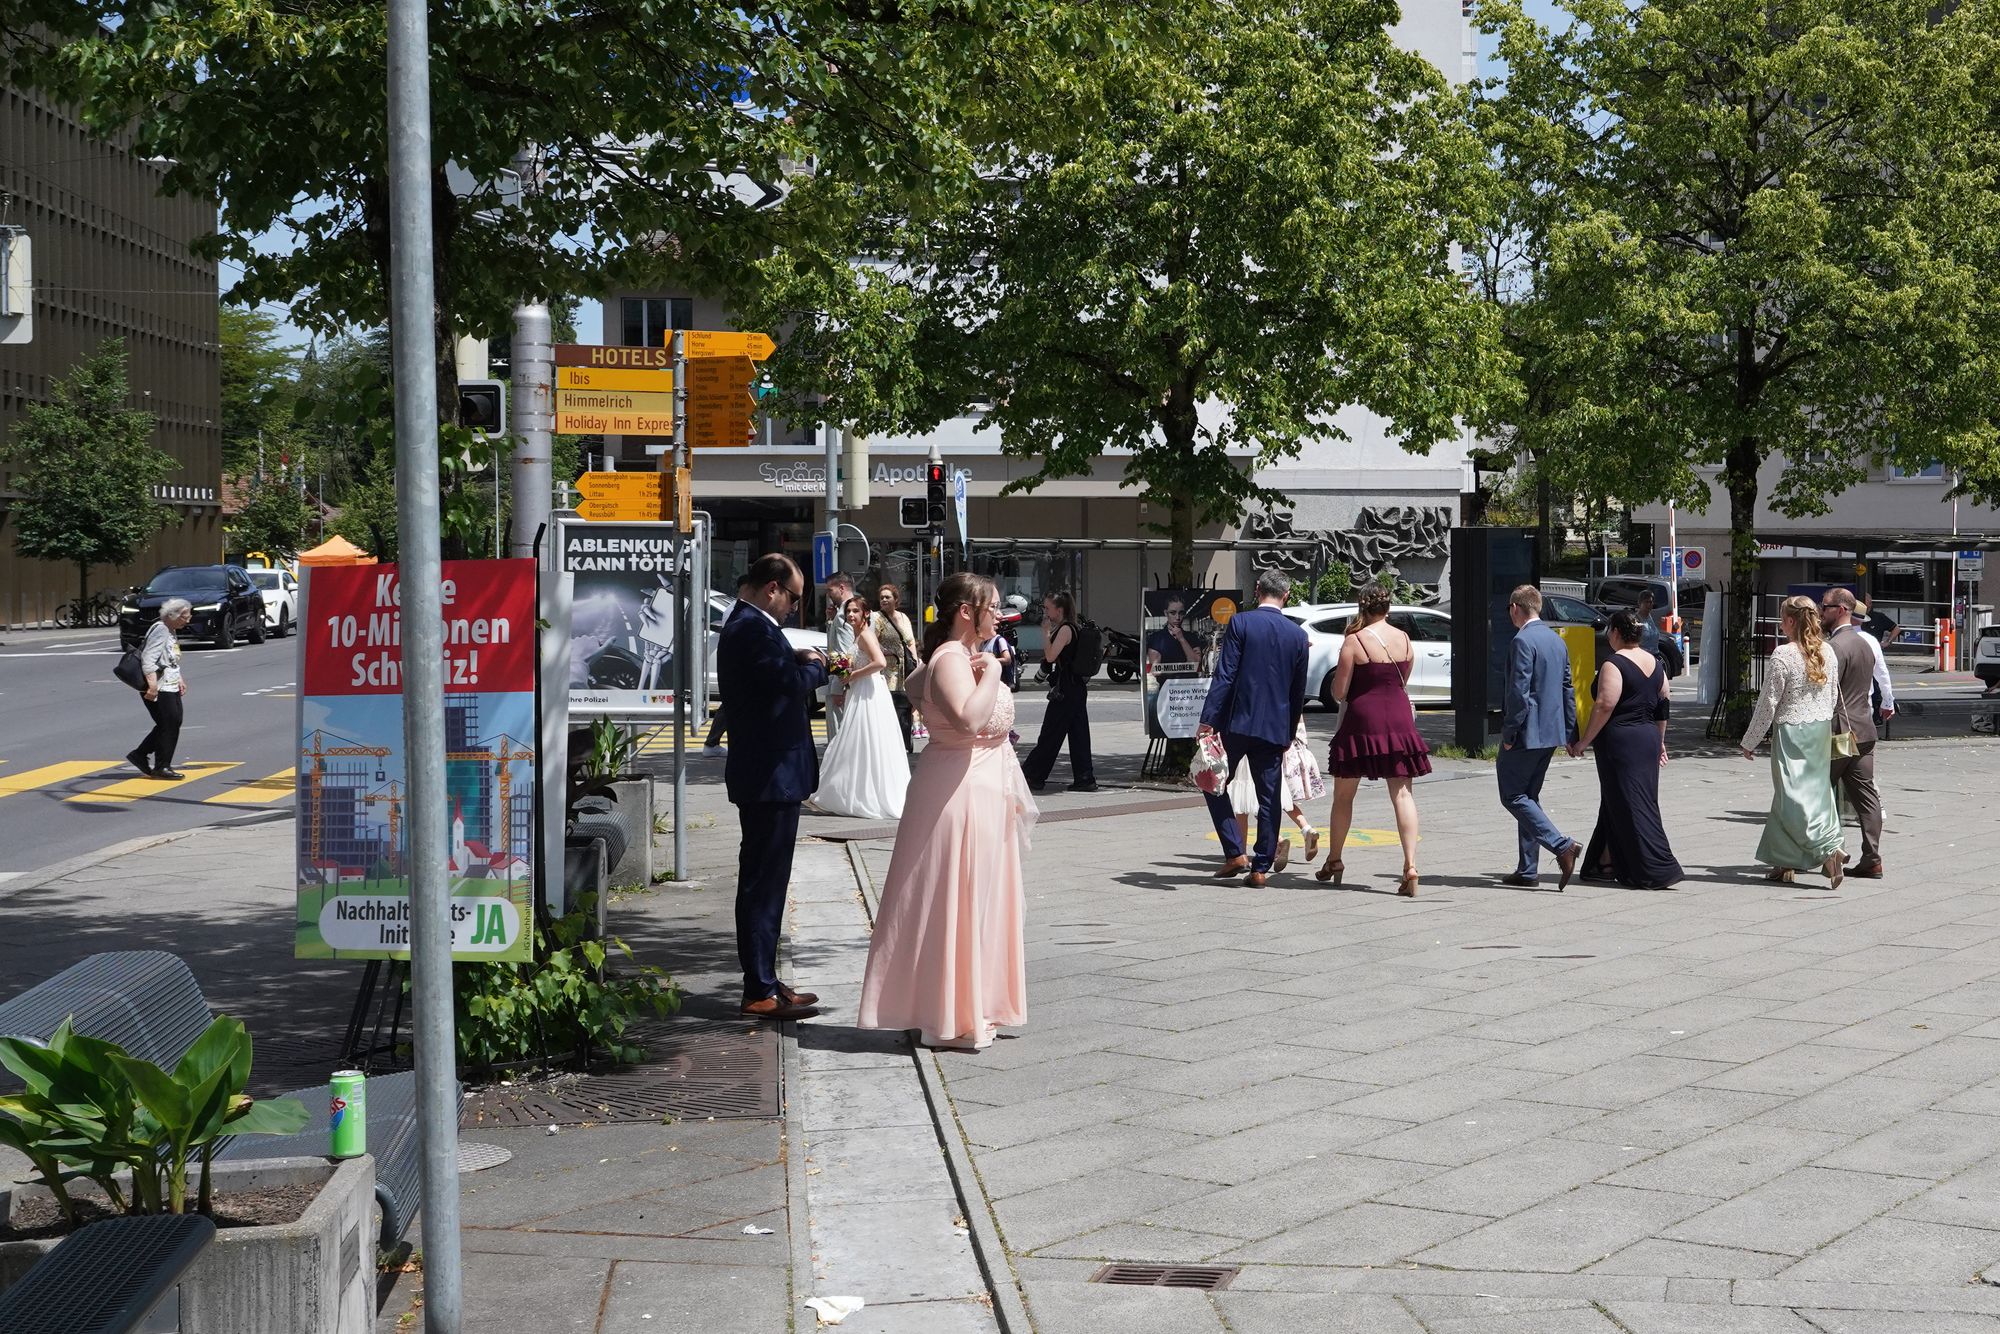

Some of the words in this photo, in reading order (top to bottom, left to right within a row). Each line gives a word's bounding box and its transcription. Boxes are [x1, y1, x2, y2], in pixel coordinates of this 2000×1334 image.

[591, 348, 667, 367] HOTELS
[570, 371, 590, 385] Ibis
[564, 393, 633, 409] Himmelrich
[565, 415, 608, 433] Holiday
[613, 417, 631, 430] Inn
[152, 485, 213, 500] TADTHAUS
[785, 482, 801, 491] mit
[802, 482, 817, 491] der
[568, 557, 625, 571] KANN
[1662, 551, 1670, 562] P
[351, 649, 479, 687] Schiz!
[470, 903, 507, 945] JA
